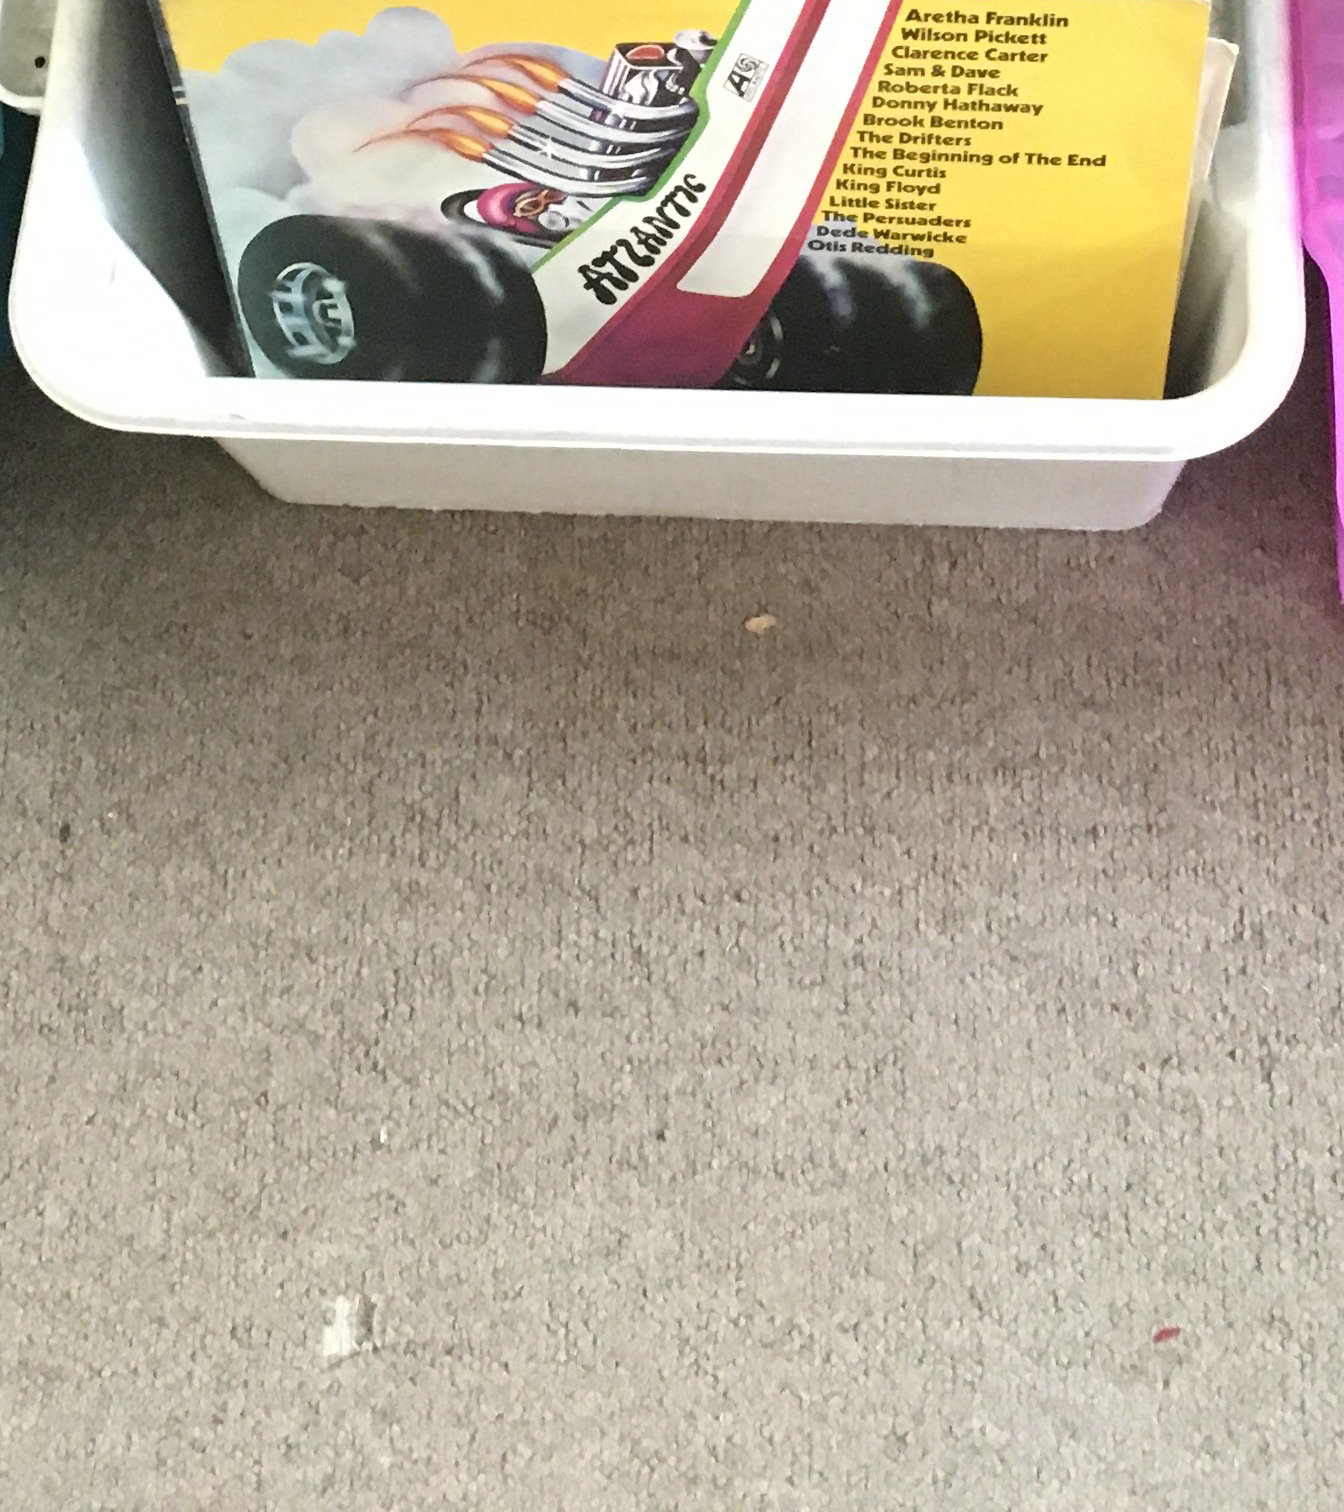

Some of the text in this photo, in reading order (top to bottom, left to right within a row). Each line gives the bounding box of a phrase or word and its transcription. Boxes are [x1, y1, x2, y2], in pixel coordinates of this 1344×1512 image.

[905, 8, 1069, 28] Aretha Franklin
[900, 27, 1048, 45] Wilson Pickett
[891, 45, 1048, 63] Clarence Carter
[883, 63, 1001, 79] Sam & Dave
[877, 80, 1019, 97] Roberta Flack
[871, 96, 1044, 117] Donny Hathaway
[863, 113, 1004, 131] Brook Benton
[856, 130, 972, 147] The Drifters
[849, 146, 1106, 167] The Beginning of The End
[842, 162, 947, 179] King Curtis
[835, 179, 941, 195] King Floyd
[829, 195, 937, 212] Little Sister
[821, 210, 972, 228] The Persuaders
[577, 173, 707, 306] ATLANTIC
[816, 225, 968, 244] Dede Warwicke
[807, 239, 935, 258] Otis Redding
